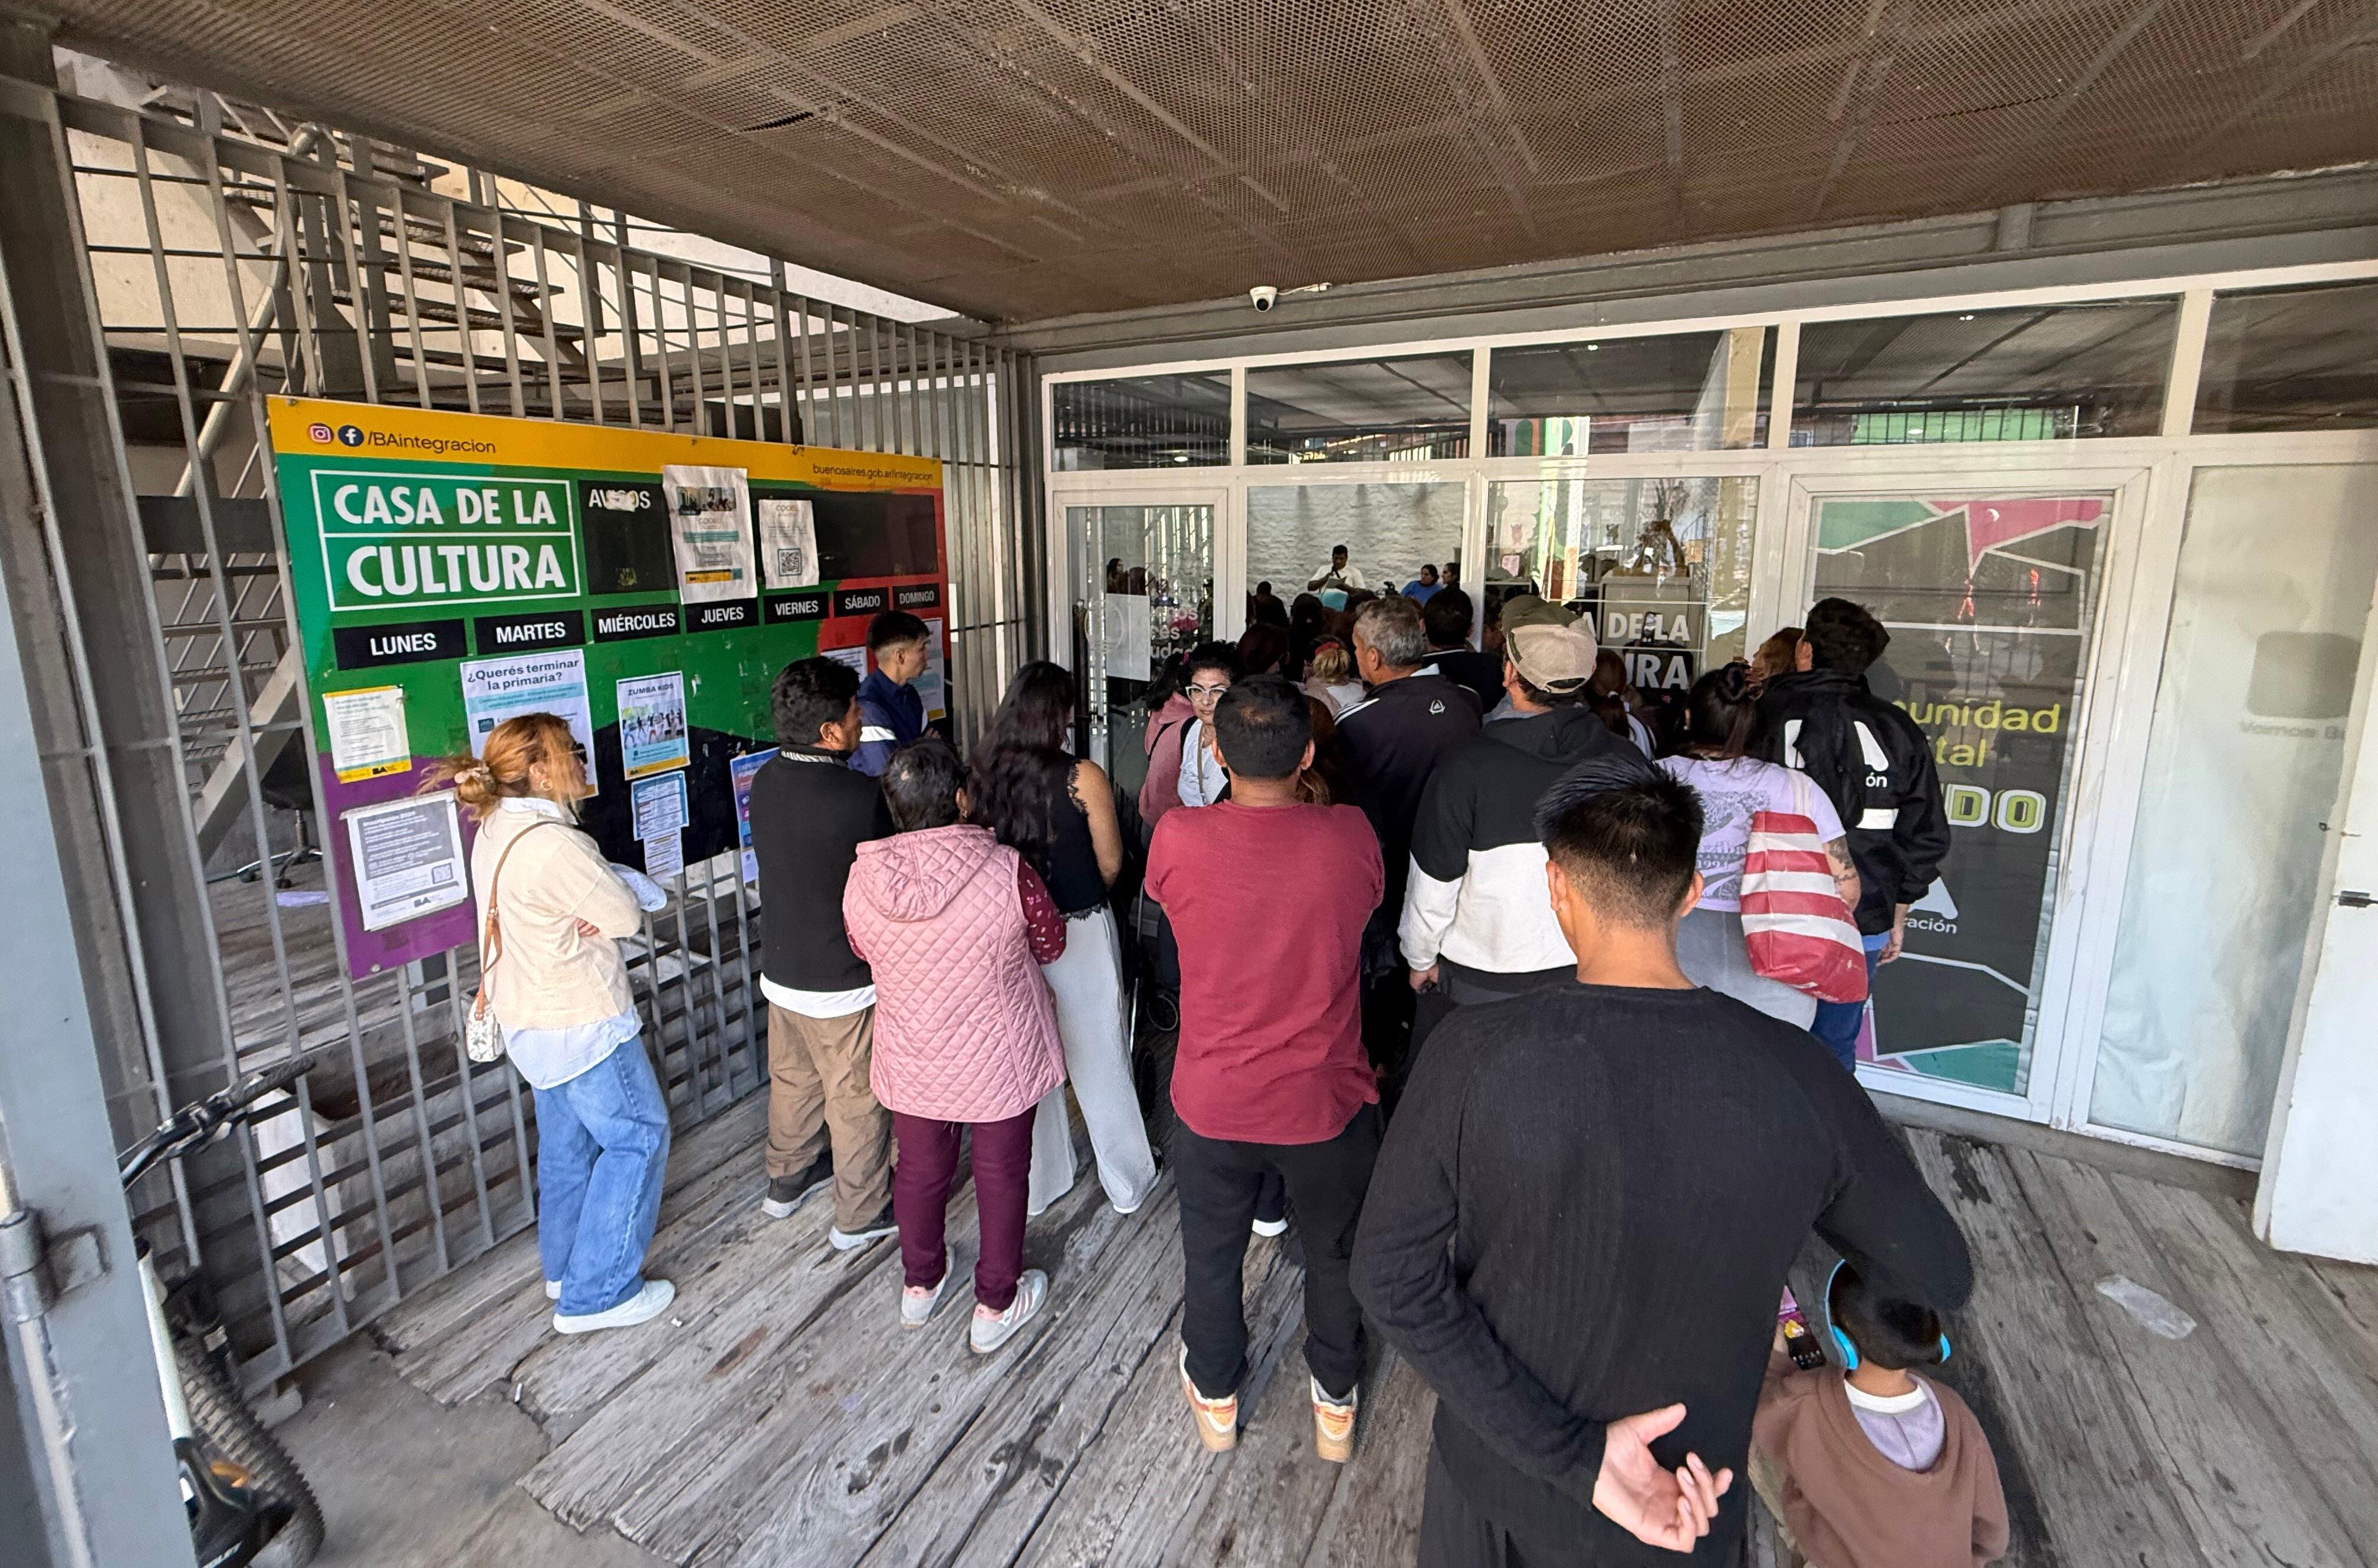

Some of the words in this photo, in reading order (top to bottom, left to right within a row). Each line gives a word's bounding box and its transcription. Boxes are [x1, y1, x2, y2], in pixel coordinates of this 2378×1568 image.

[367, 430, 497, 454] /BAintegracion
[813, 464, 933, 482] buenosaires.gob.ar/integracion
[334, 484, 444, 525] CASA
[456, 488, 502, 524] DE
[513, 489, 557, 524] LA
[347, 544, 567, 597] CULTURA
[775, 600, 819, 616] VIERNES
[845, 594, 881, 610] SÁBADO
[899, 591, 934, 604] DOMINGO
[599, 613, 676, 634] MIÉRCOLES
[701, 607, 744, 624] JUEVES
[496, 622, 566, 643] MARTES
[1608, 612, 1643, 639] DE
[1654, 614, 1690, 642] LA
[370, 633, 437, 656] LUNES
[468, 666, 524, 683] ¿Querés
[527, 659, 579, 673] terminar
[487, 681, 500, 690] la
[503, 672, 562, 690] primaria?
[628, 685, 656, 696] ZUMBA
[658, 682, 674, 691] KIDS
[1943, 783, 2047, 833] DO
